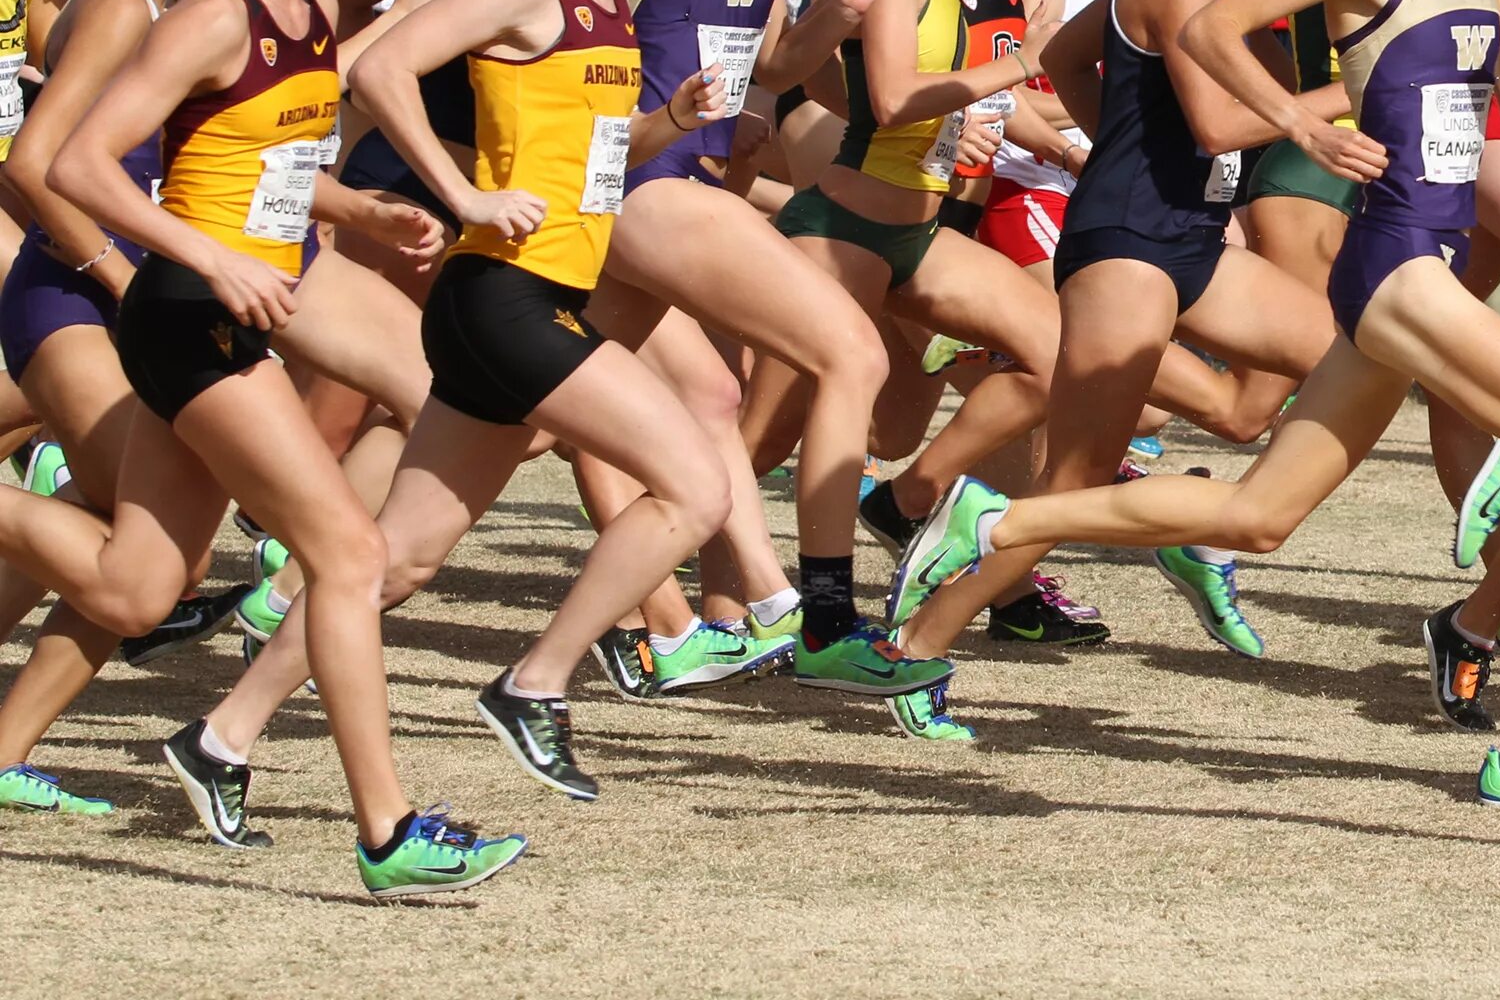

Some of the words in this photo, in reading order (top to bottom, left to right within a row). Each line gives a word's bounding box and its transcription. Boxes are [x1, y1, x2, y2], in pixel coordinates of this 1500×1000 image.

[1450, 25, 1496, 70] W
[584, 64, 628, 87] ARIZONA
[276, 103, 319, 127] ARIZONA
